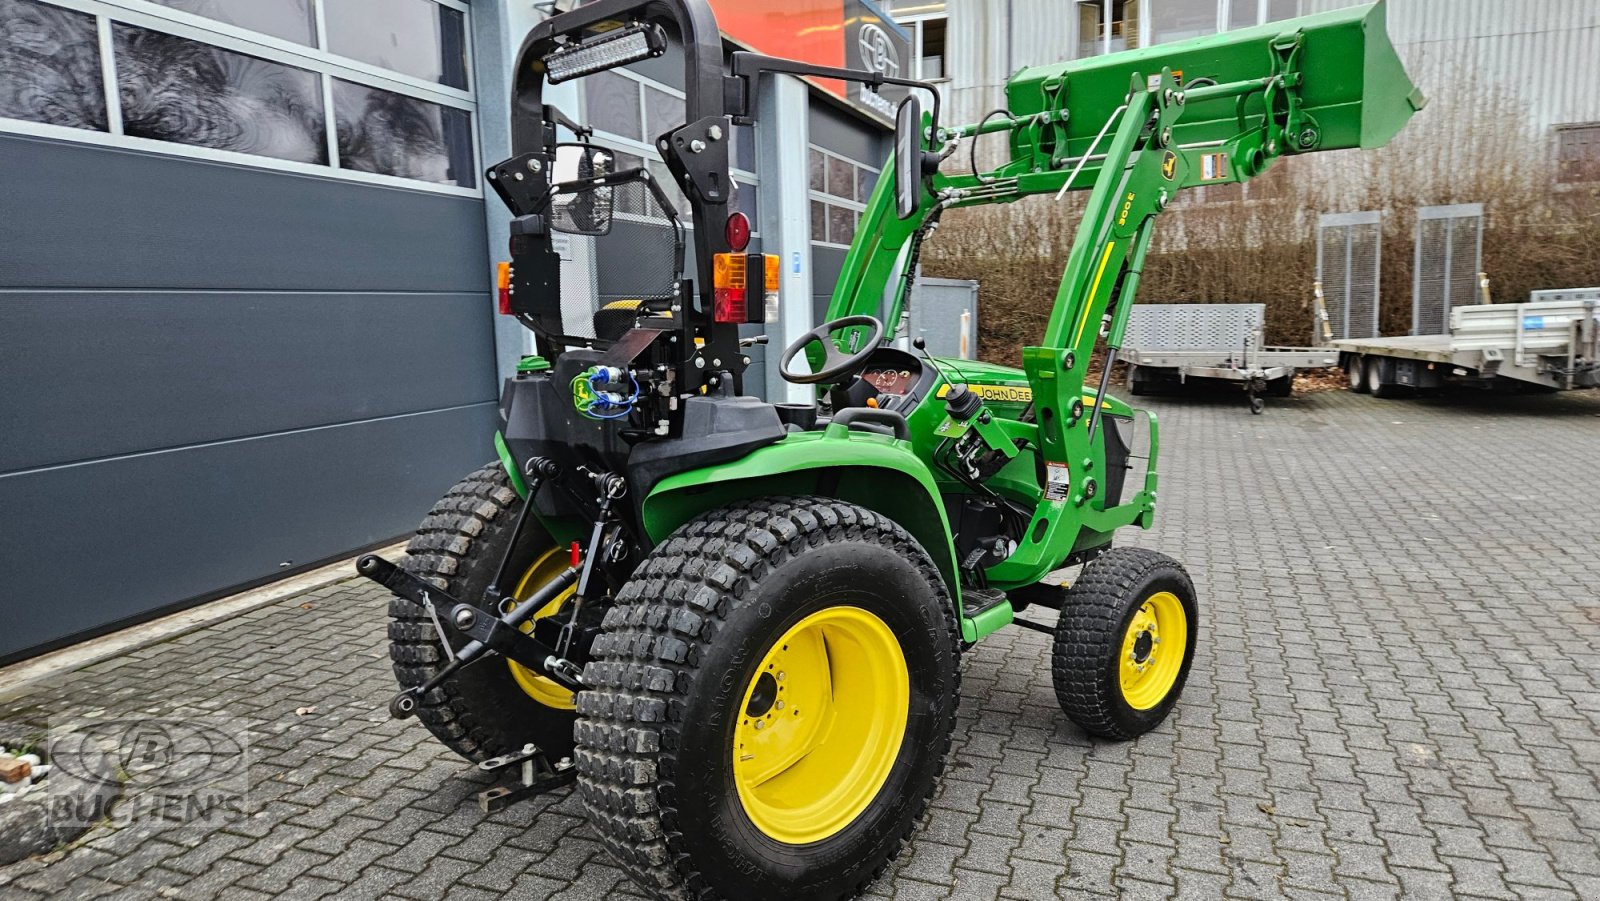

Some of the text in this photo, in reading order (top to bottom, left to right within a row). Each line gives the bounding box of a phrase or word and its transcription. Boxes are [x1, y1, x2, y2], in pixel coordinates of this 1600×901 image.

[1119, 192, 1136, 226] 300E
[980, 387, 1031, 400] JOHN DEE
